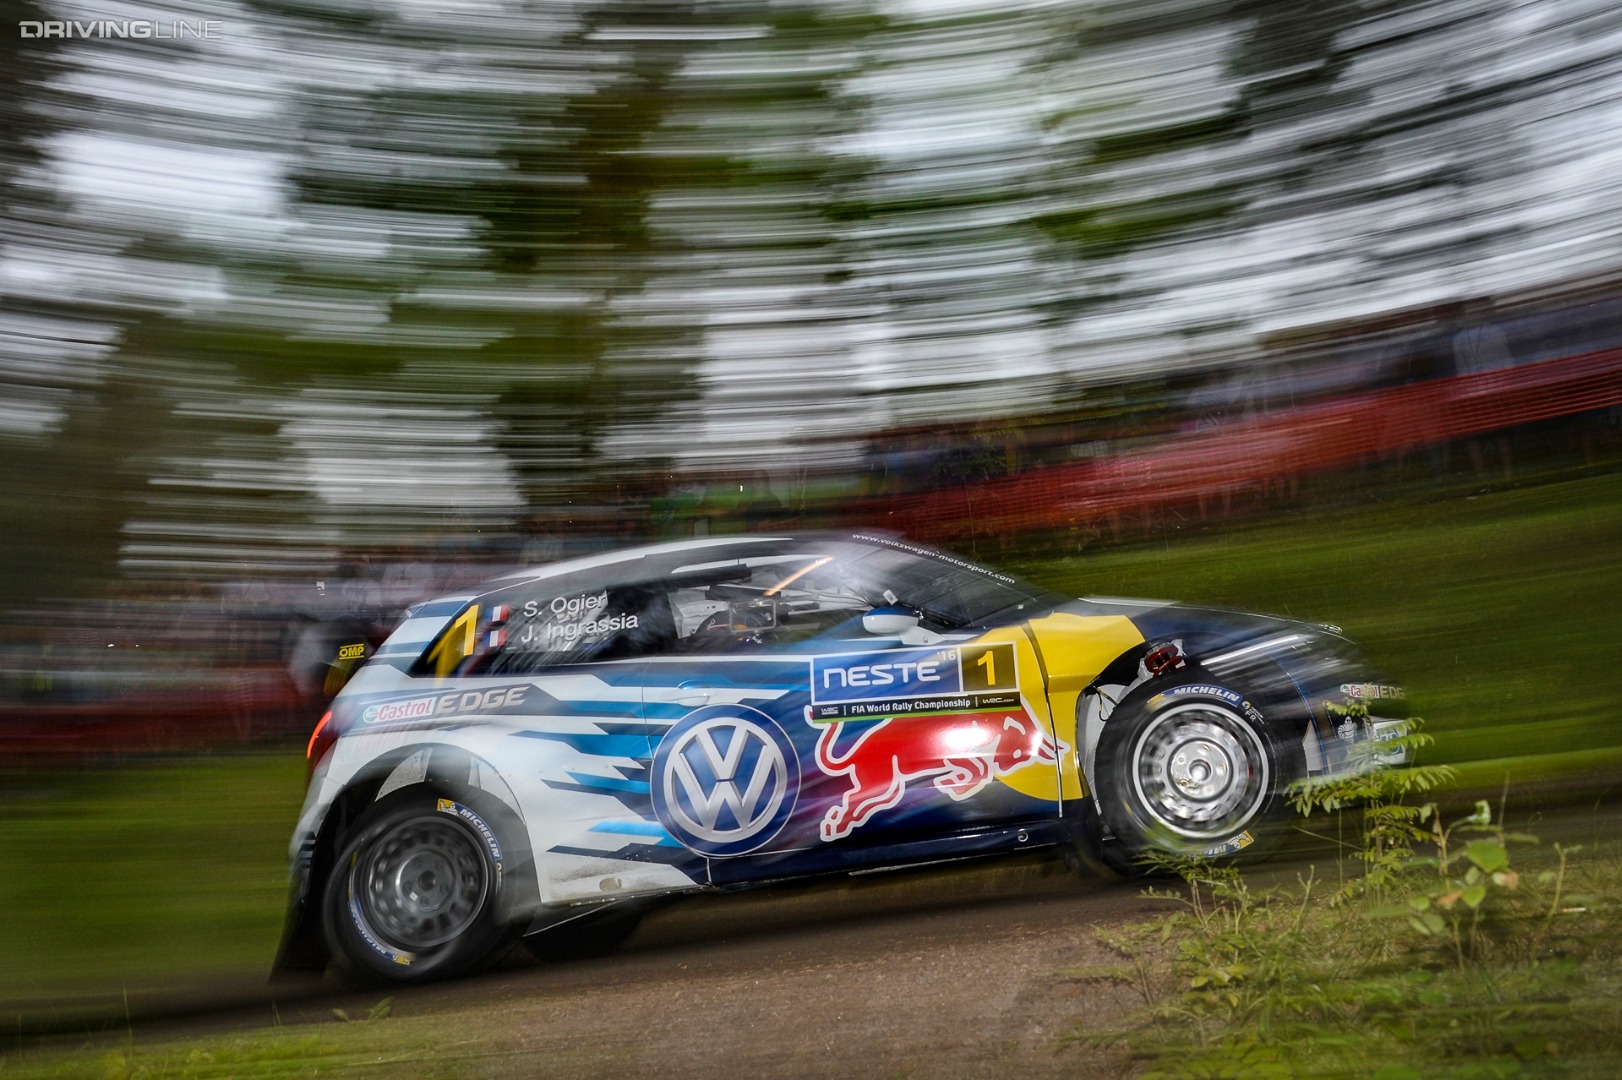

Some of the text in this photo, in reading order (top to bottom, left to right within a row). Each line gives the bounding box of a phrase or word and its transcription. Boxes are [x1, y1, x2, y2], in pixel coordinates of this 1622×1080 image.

[852, 533, 1016, 585] www.volkswagen-motorsport.com
[523, 594, 608, 617] S. Ogier
[454, 604, 479, 655] 1
[521, 612, 639, 643] J. Ingrassia
[339, 646, 365, 657] OMP
[823, 661, 940, 689] NESTE
[977, 650, 996, 686] 1
[378, 687, 530, 721] Castrol EDGE
[851, 698, 971, 714] FIA World Rally Championship
[1174, 686, 1240, 702] MICHELIN
[459, 808, 501, 858] MICHELIN
